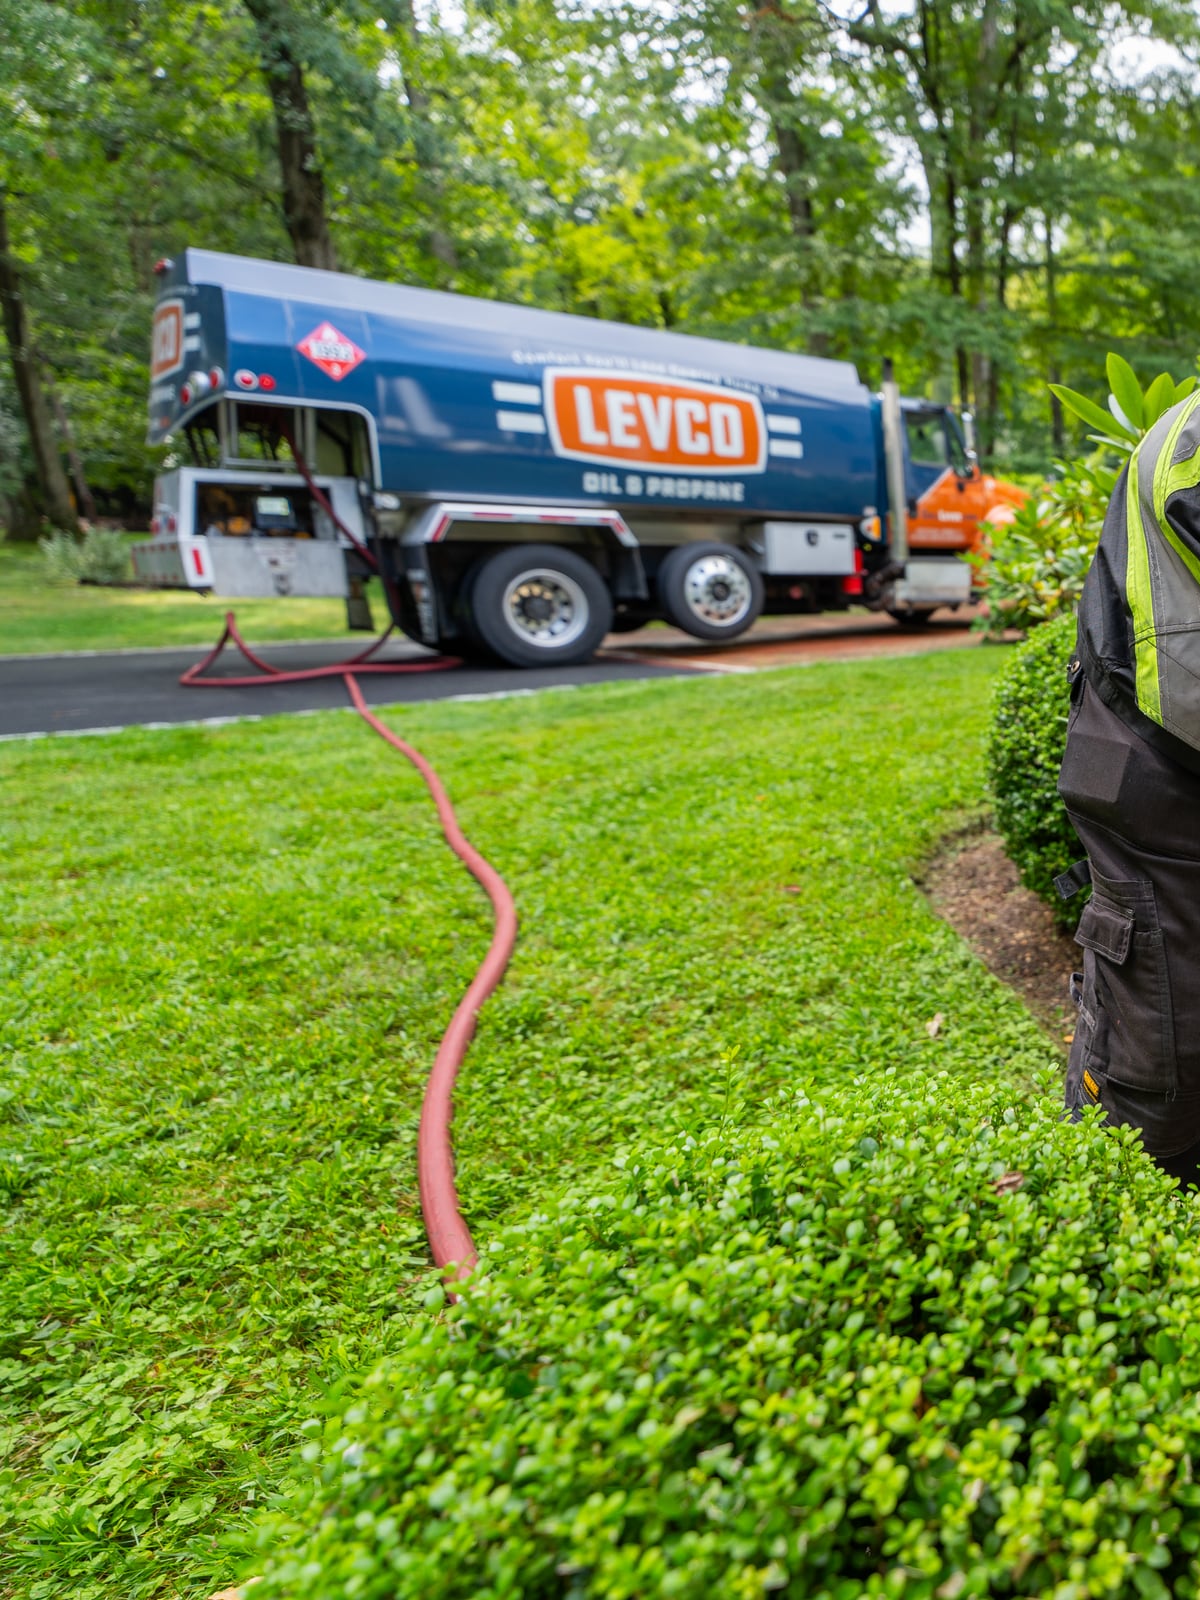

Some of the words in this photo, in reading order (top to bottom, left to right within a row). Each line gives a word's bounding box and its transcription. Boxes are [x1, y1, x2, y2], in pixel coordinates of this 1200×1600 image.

[572, 384, 746, 459] LEVCO
[582, 471, 623, 495] OIL
[646, 475, 745, 502] PROPANE
